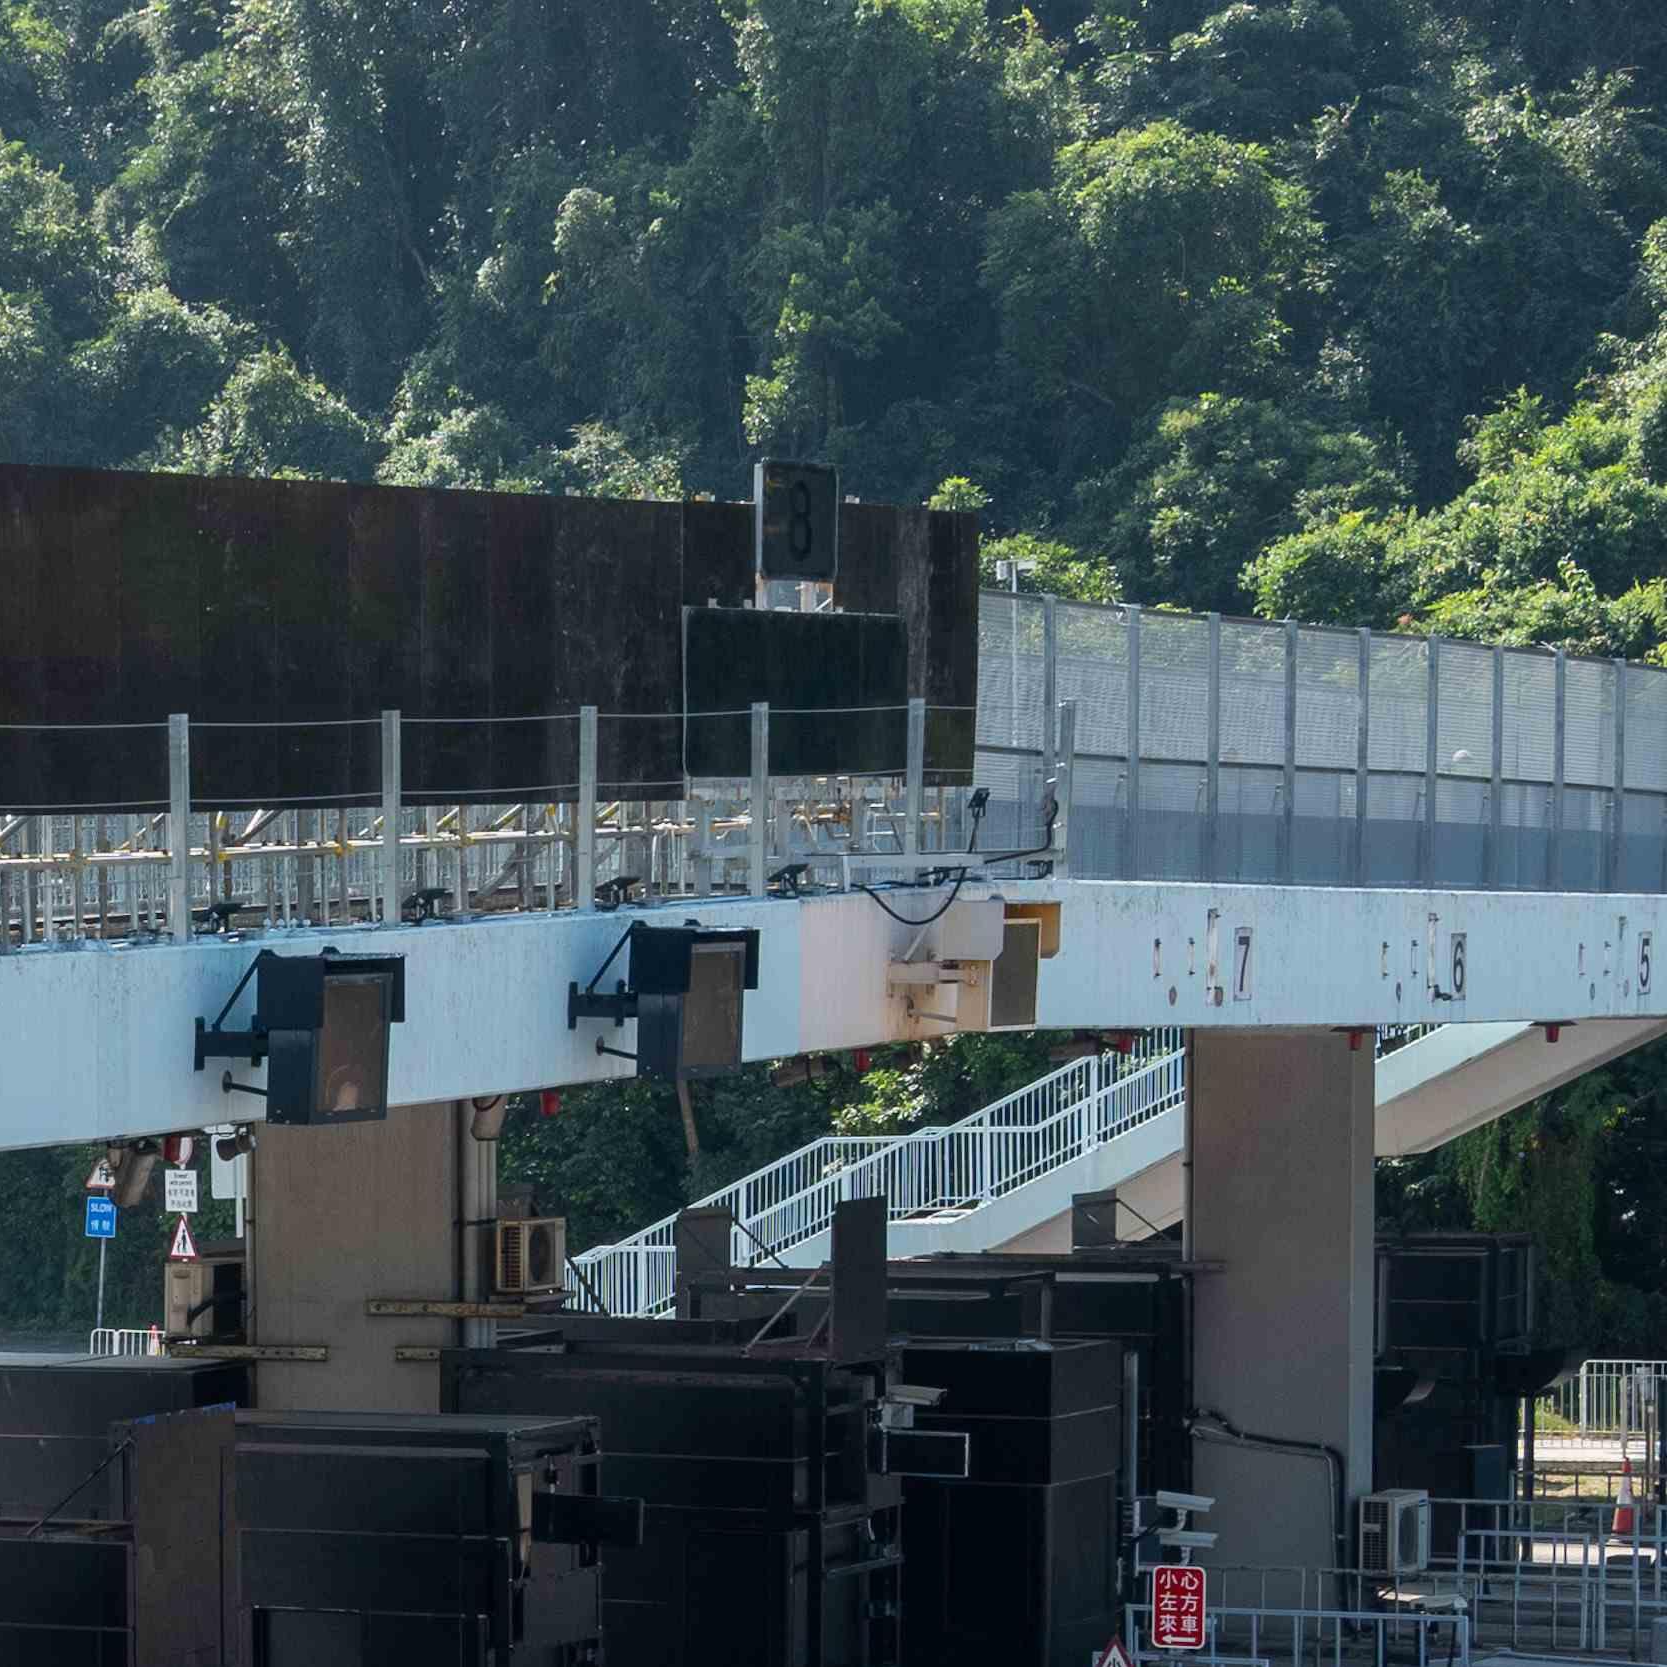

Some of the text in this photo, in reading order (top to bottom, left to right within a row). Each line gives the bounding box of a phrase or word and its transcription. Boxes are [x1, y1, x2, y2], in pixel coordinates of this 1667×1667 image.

[1238, 936, 1250, 992] 7
[1453, 940, 1464, 993] 6
[1639, 937, 1651, 987] 5
[1159, 1571, 1199, 1590] 小心
[1159, 1592, 1199, 1612] 左方
[1159, 1614, 1199, 1634] 來車
